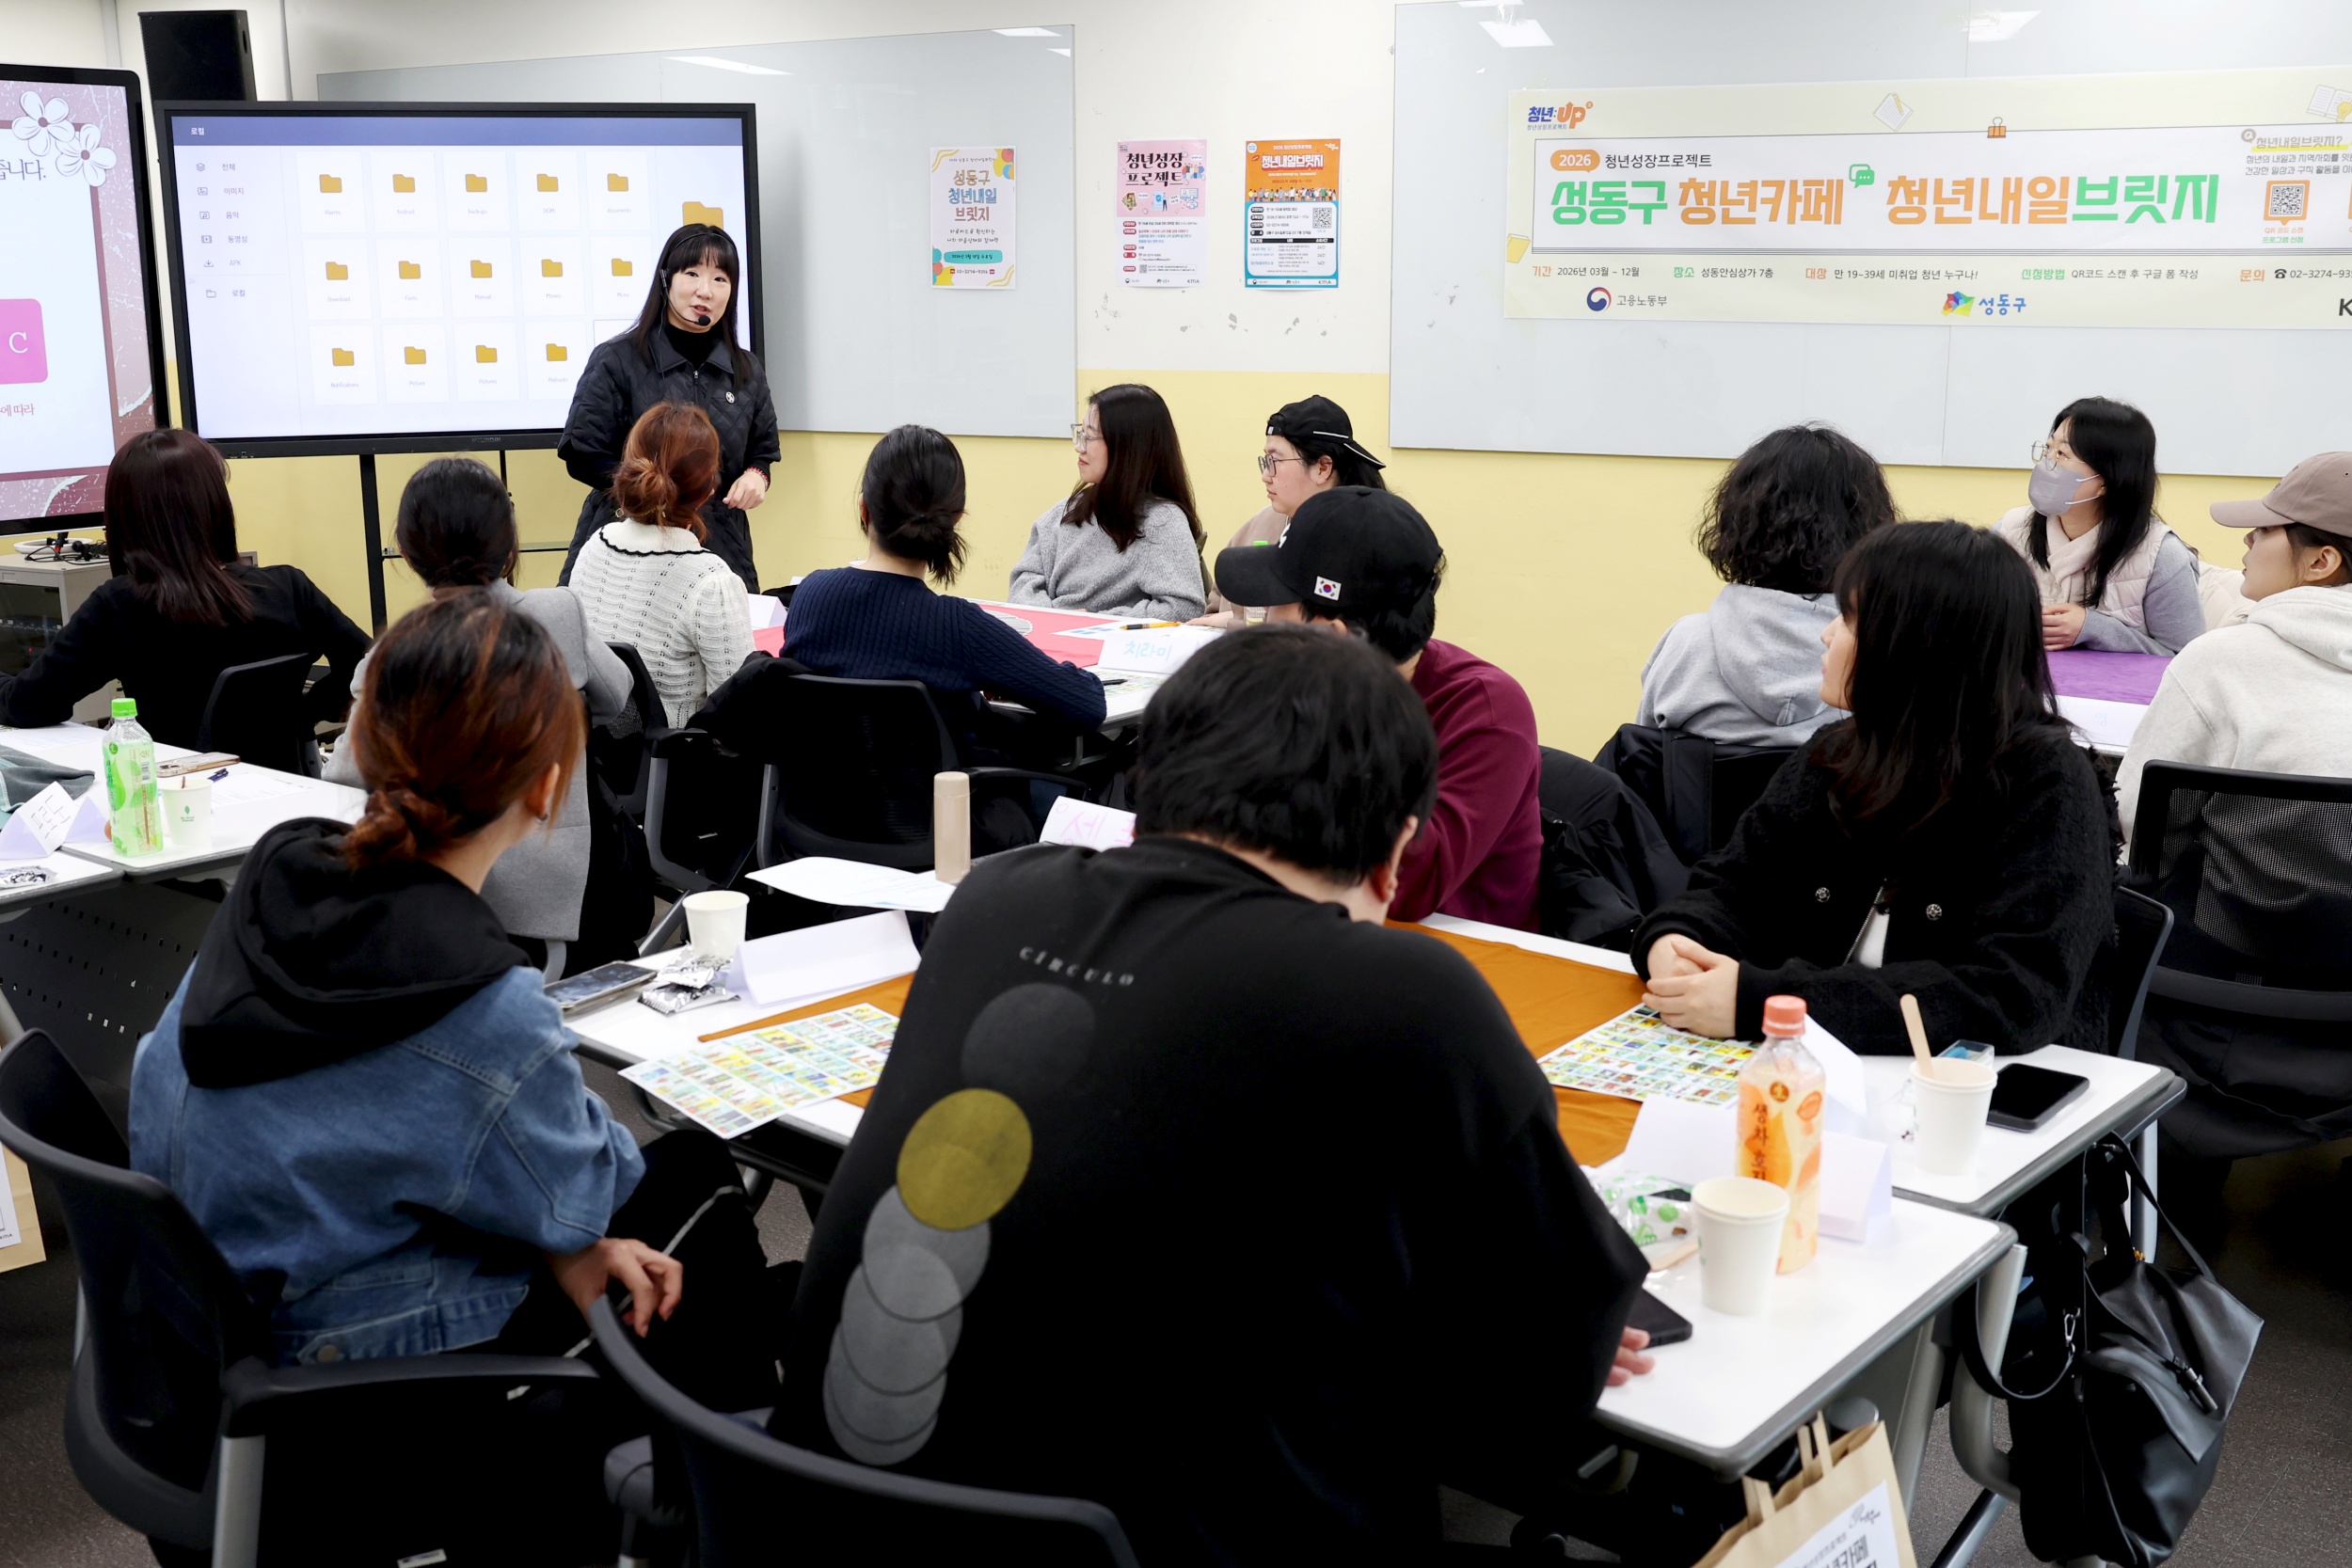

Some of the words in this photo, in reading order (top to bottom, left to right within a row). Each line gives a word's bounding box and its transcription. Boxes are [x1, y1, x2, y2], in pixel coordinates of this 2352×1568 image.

[190, 127, 205, 135] 로컬
[2256, 135, 2343, 149] 청년내일브릿지?
[1126, 152, 1183, 169] 청년성장
[1262, 154, 1324, 168] 청년내일브릿지
[1559, 154, 1592, 166] 2026
[1605, 154, 1712, 168] 청년성장프로젝트
[2246, 154, 2270, 165] 청년의
[2272, 154, 2296, 164] 내일과
[2297, 153, 2339, 163] 지역사회를
[222, 163, 236, 171] 전체
[2246, 166, 2269, 176] 건강한
[2271, 166, 2296, 175] 일상과
[2297, 166, 2313, 175] 구직
[2315, 166, 2341, 175] 활동을
[953, 169, 991, 186] 성동구
[1125, 171, 1184, 187] 프로젝트
[224, 187, 245, 196] 이미지
[948, 187, 997, 204] 청년내일
[1550, 181, 1668, 225] 성동구
[1678, 177, 1844, 225] 청년카페
[1886, 174, 2219, 225] 청년내일브릿지
[955, 206, 990, 222] 브릿지
[228, 235, 248, 244] 동영상
[1532, 266, 1551, 277] 기간
[1557, 267, 1587, 277] 2026년
[1590, 267, 1609, 277] 03월
[1621, 267, 1640, 277] 12월
[1674, 266, 1695, 278] 장소
[1701, 266, 1756, 279] 성동안심상가
[1758, 266, 1774, 279] 7층
[1805, 268, 1827, 279] 대상
[1834, 269, 1844, 279] 만
[1847, 269, 1885, 279] 19~39세
[1888, 269, 1918, 280] 미취업
[1921, 269, 1941, 280] 청년
[1945, 269, 1979, 280] 누구나!
[2021, 268, 2066, 280] 신청방법
[2071, 269, 2104, 279] QR코드
[2106, 269, 2127, 279] 스캔
[2129, 269, 2139, 279] 후
[2143, 269, 2163, 279] 구글
[2166, 269, 2176, 279] 폼
[2179, 269, 2199, 279] 작성
[2240, 269, 2265, 282] 문의
[1616, 294, 1668, 307] 고용노동부
[1978, 293, 2027, 316] 성동구
[8, 331, 29, 354] C
[13, 404, 35, 416] 따라
[1123, 640, 1173, 661] 치라미
[1019, 945, 1135, 987] CIRCULO
